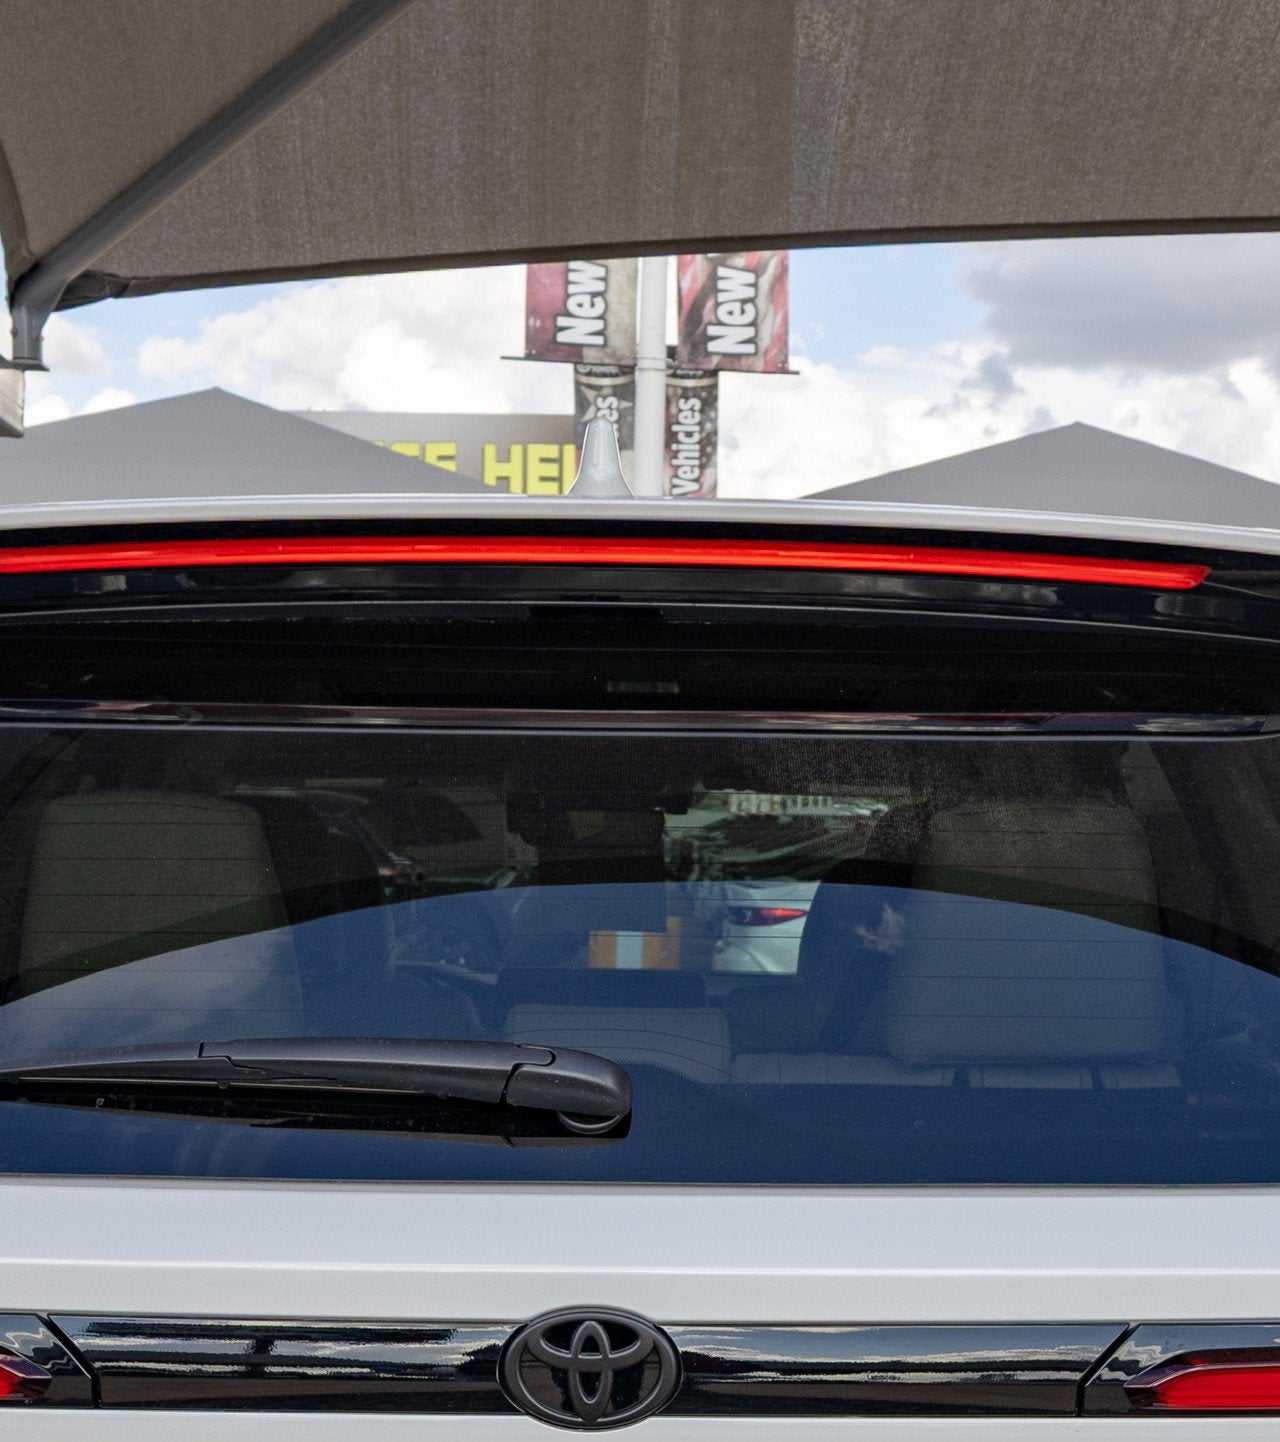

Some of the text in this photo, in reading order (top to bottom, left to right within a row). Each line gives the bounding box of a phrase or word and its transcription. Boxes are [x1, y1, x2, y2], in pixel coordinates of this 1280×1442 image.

[555, 260, 607, 346] New
[706, 265, 758, 355] New
[671, 397, 702, 496] Vehicles
